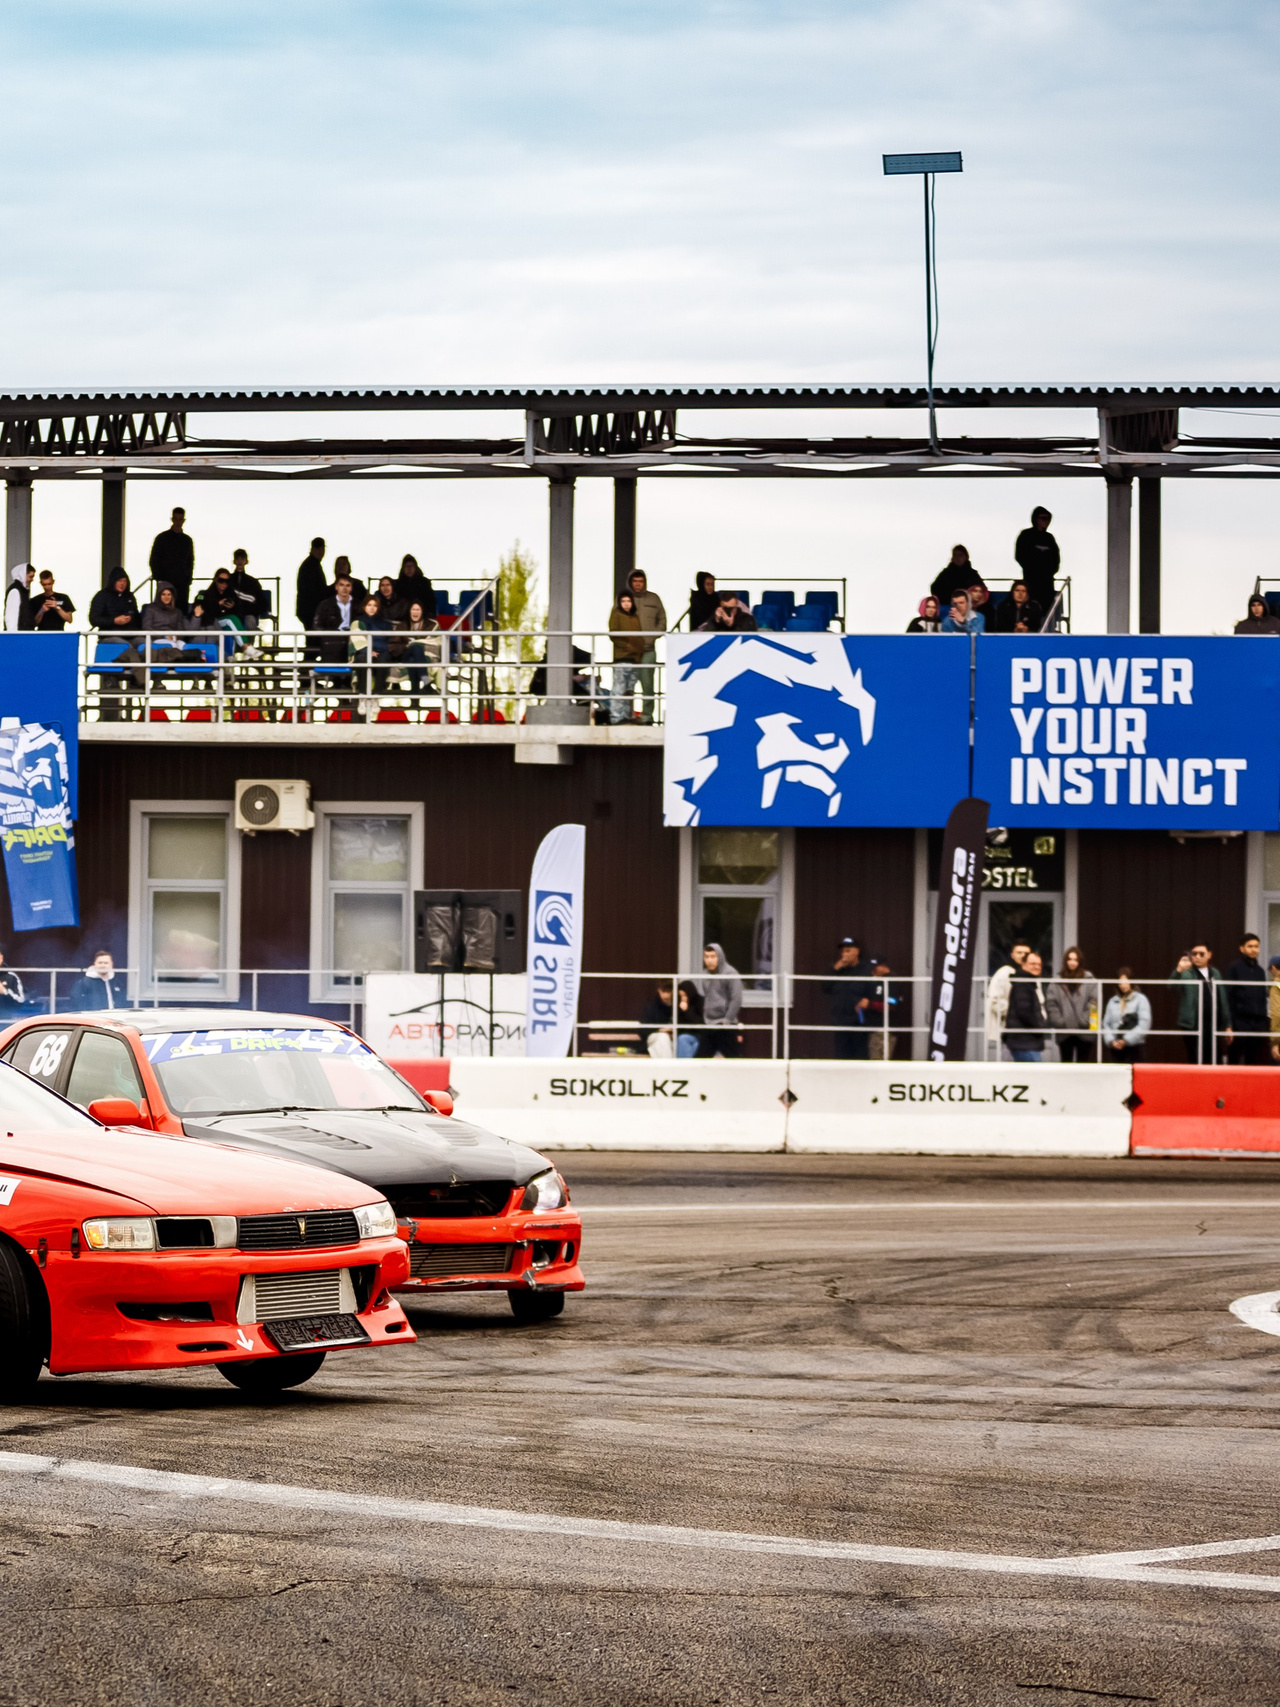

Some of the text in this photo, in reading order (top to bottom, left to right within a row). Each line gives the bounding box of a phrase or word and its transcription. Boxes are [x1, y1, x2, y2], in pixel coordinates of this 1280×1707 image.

[1011, 657, 1194, 705] POWER
[1010, 707, 1148, 755] YOUR
[1010, 757, 1248, 806] INSTINCT
[959, 852, 976, 960] KAZAKHSTAN
[29, 1034, 69, 1077] 68
[550, 1078, 689, 1097] SOKOL.KZ
[889, 1084, 1029, 1102] SOKOL.KZ
